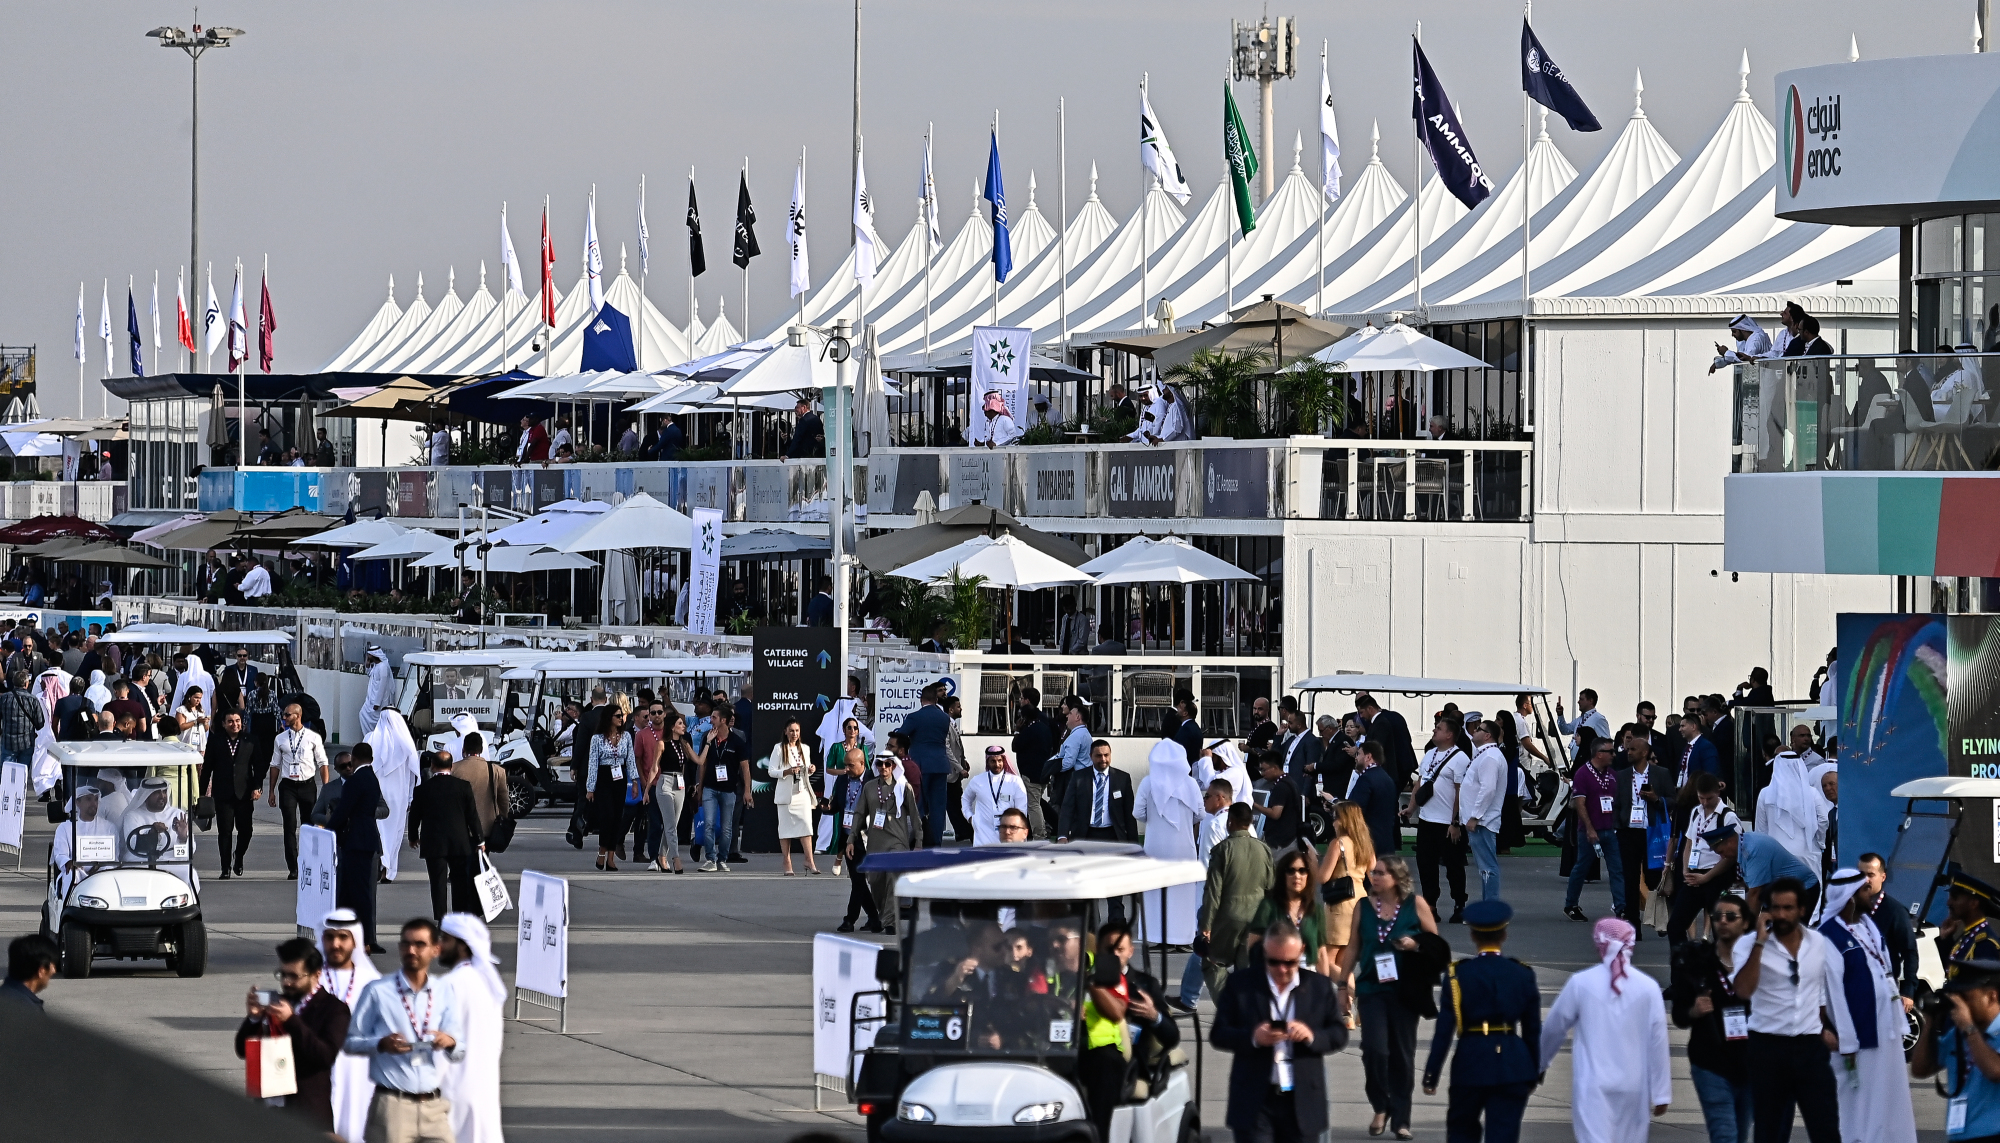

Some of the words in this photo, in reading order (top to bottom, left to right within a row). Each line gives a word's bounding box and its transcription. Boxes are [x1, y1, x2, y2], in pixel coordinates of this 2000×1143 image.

[1807, 95, 1840, 141] اينوك
[1807, 147, 1841, 178] enoc
[1037, 469, 1075, 500] BOMBARDIER
[1110, 466, 1128, 501] GAL
[1132, 465, 1174, 501] AMMROC
[763, 649, 808, 657] CATERING
[880, 675, 900, 685] المياه
[903, 676, 928, 685] دورات
[772, 692, 799, 700] RIKAS
[880, 688, 922, 699] TOILETS
[757, 703, 814, 711] HOSPITALITY
[879, 702, 916, 712] المصلى
[879, 713, 907, 723] PRAY
[176, 848, 185, 856] 29
[917, 1018, 940, 1028] Pilot
[946, 1016, 962, 1041] 6
[1054, 1029, 1067, 1039] 32
